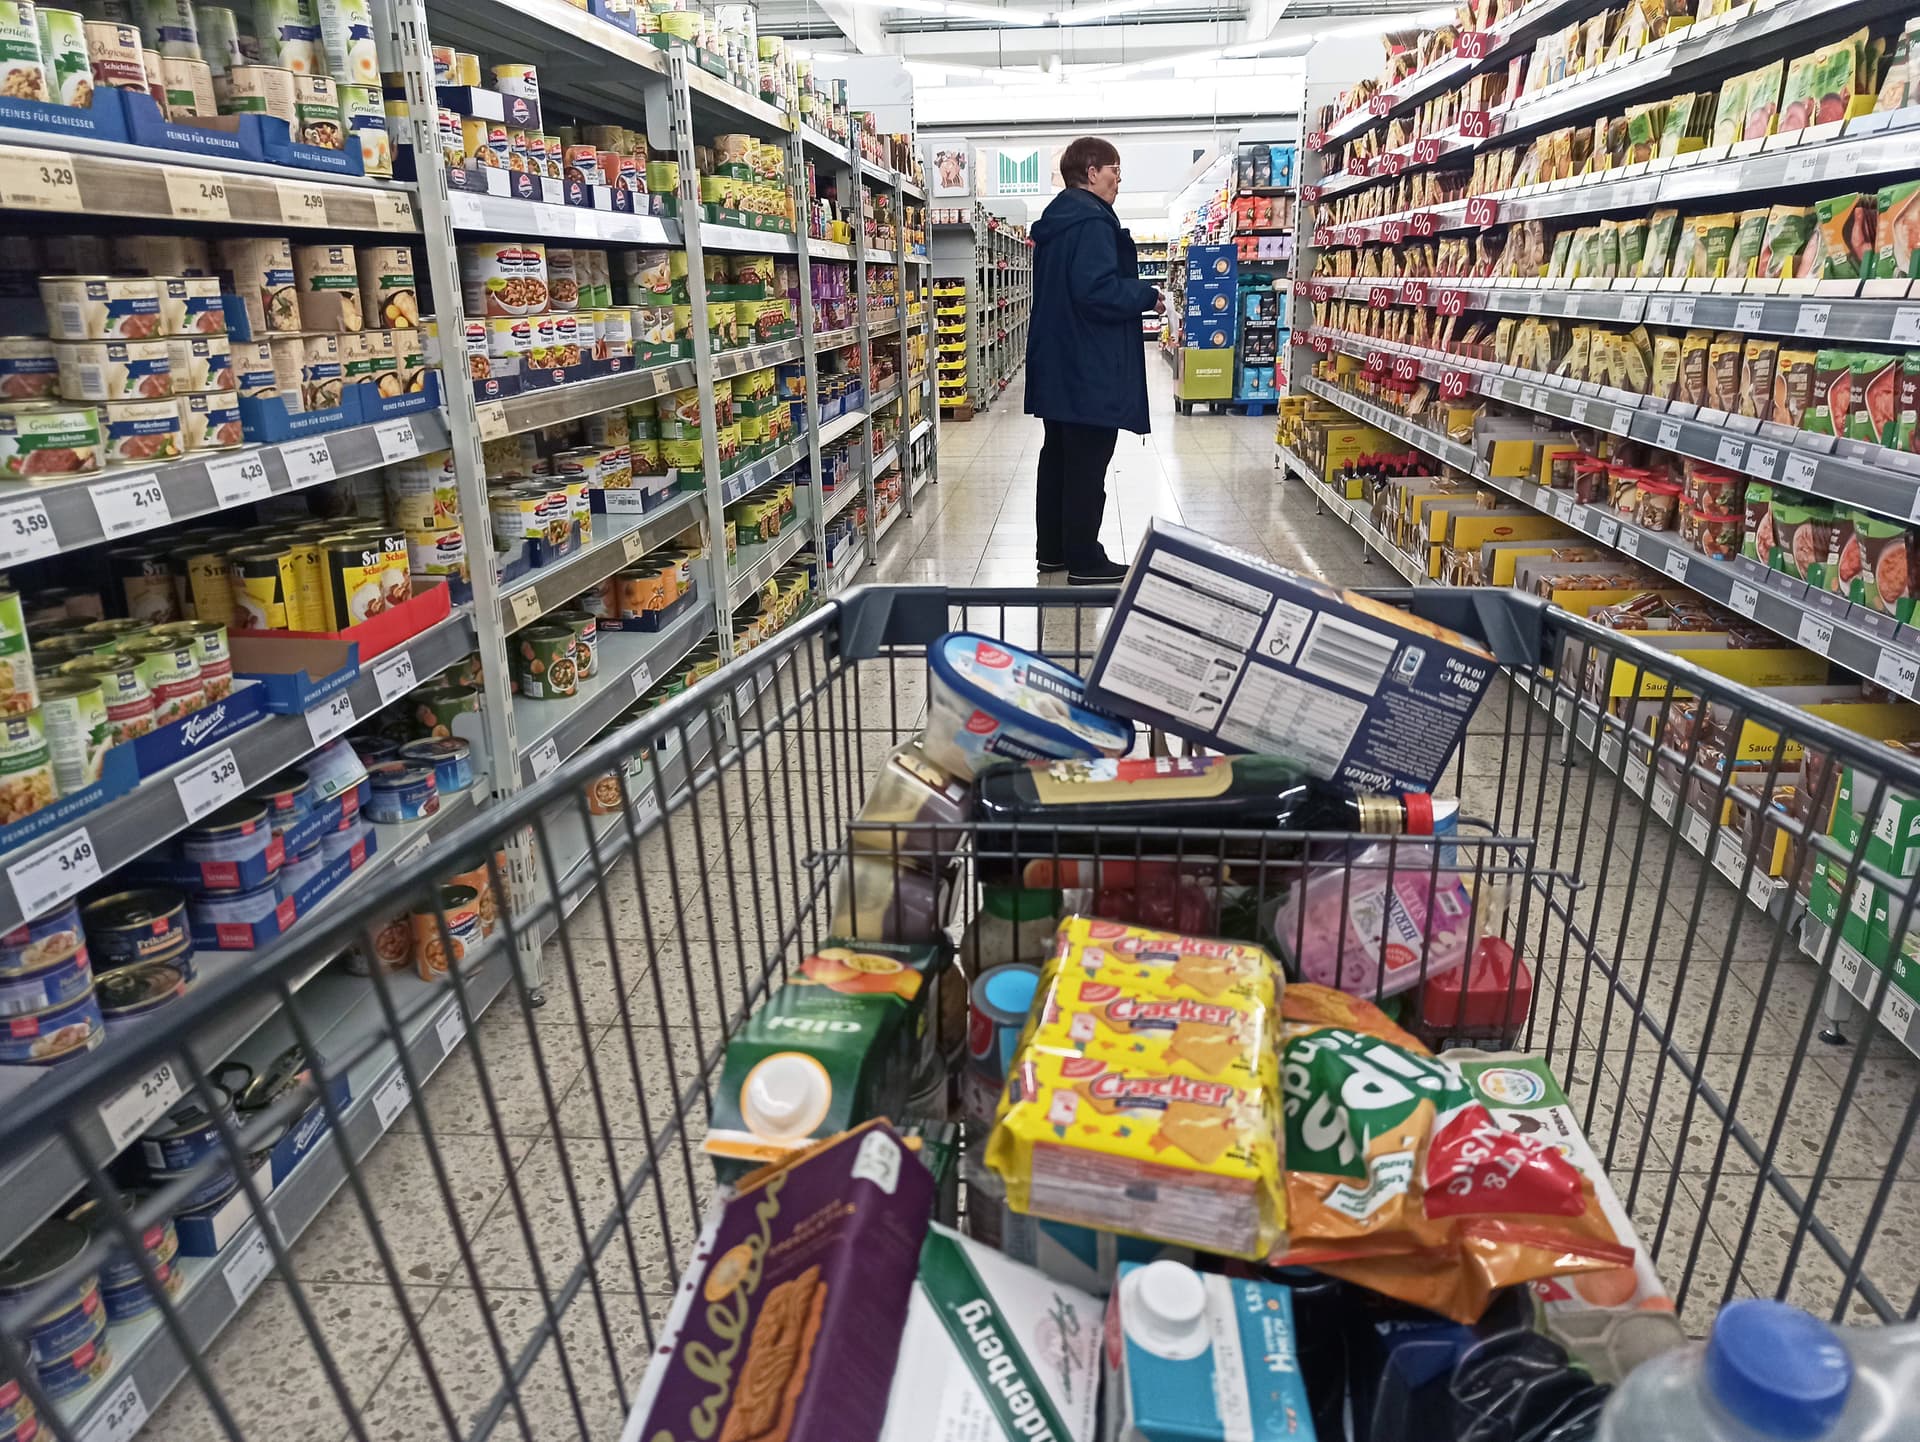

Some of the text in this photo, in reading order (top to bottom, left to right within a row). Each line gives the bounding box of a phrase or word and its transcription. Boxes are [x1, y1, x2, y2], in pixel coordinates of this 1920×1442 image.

[1461, 33, 1481, 57] %
[1371, 96, 1387, 114] %
[0, 108, 95, 129] FEINES FÜR GENIESSER
[1463, 113, 1483, 137] %
[166, 130, 191, 143] FEINES
[206, 136, 240, 149] GENIESSER
[1309, 133, 1321, 148] %
[1417, 141, 1434, 161] %
[1351, 158, 1365, 176] %
[1382, 155, 1398, 173] %
[40, 167, 73, 186] 3,29
[200, 184, 224, 201] 2,49
[303, 194, 323, 208] 2,99
[1304, 186, 1316, 200] %
[394, 202, 410, 214] 2,49
[1470, 200, 1490, 224] %
[1384, 222, 1399, 241] %
[1414, 214, 1431, 235] %
[1317, 230, 1329, 245] %
[1347, 229, 1361, 246] %
[1295, 282, 1306, 297] %
[1314, 286, 1327, 301] %
[1372, 288, 1387, 307] %
[1406, 282, 1423, 302] %
[1442, 292, 1460, 314] %
[1814, 312, 1827, 324] 1,09
[1292, 332, 1304, 346] %
[1314, 337, 1327, 352] %
[1369, 353, 1383, 372] %
[1396, 359, 1413, 380] %
[1444, 372, 1463, 395] %
[309, 449, 329, 465] 3,29
[240, 464, 263, 480] 4,29
[1802, 465, 1814, 478] 1,09
[133, 487, 162, 507] 2,19
[12, 513, 48, 536] 3,59
[1817, 629, 1830, 642] 1,09
[396, 662, 411, 678] 3,79
[1898, 666, 1915, 683] 1,09
[331, 697, 350, 716] 2,49
[211, 762, 236, 784] 3,29
[1343, 765, 1392, 793] Kuchen
[2, 788, 104, 845] FEINES FÜR GENIESSER
[58, 842, 92, 871] 3,49
[1757, 880, 1771, 896] 1,49
[1114, 936, 1234, 957] Cracker
[1840, 955, 1857, 975] 1,59
[1107, 999, 1236, 1026] Cracker
[1891, 1001, 1910, 1023] 1,59
[141, 1066, 171, 1098] 2,39
[1091, 1072, 1234, 1106] Cracker
[1482, 1172, 1507, 1190] &
